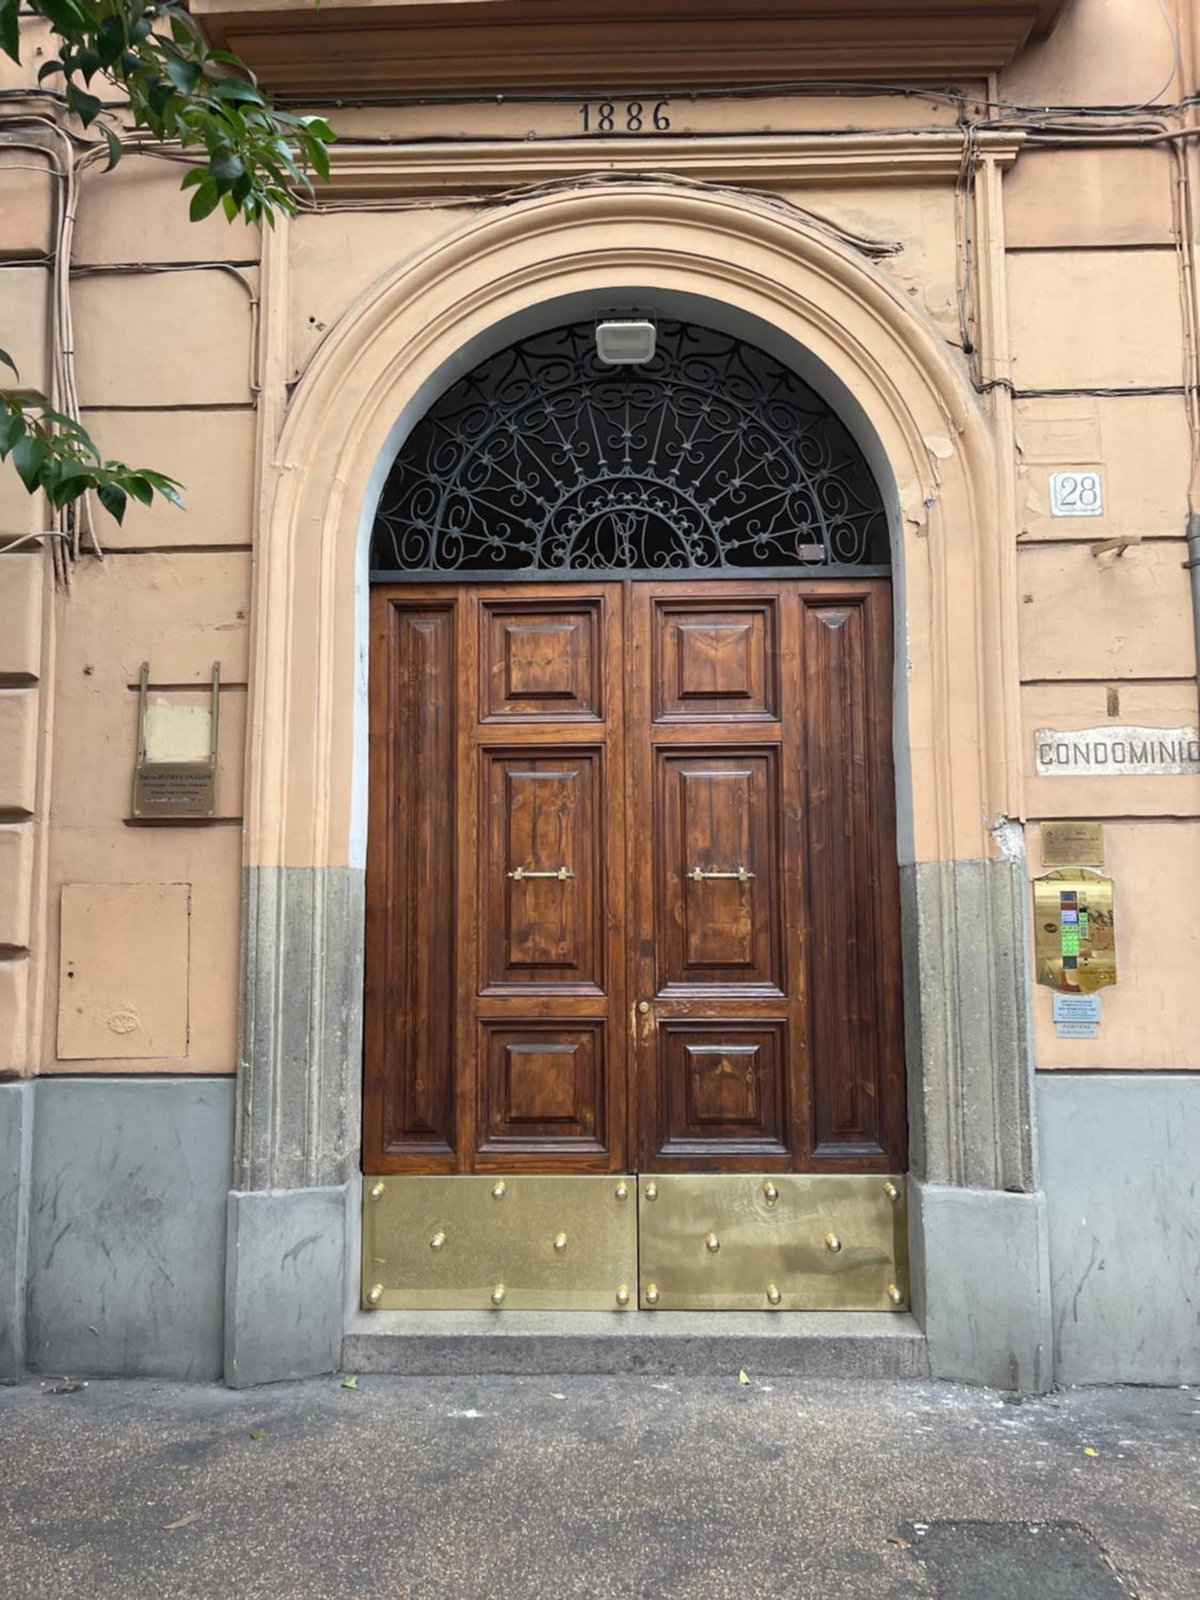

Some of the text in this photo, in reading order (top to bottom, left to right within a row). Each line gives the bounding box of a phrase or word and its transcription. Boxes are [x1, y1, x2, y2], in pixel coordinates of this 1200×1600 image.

[579, 101, 670, 132] 1886
[1060, 476, 1097, 506] 28
[1039, 741, 1200, 765] CONDOMINIO
